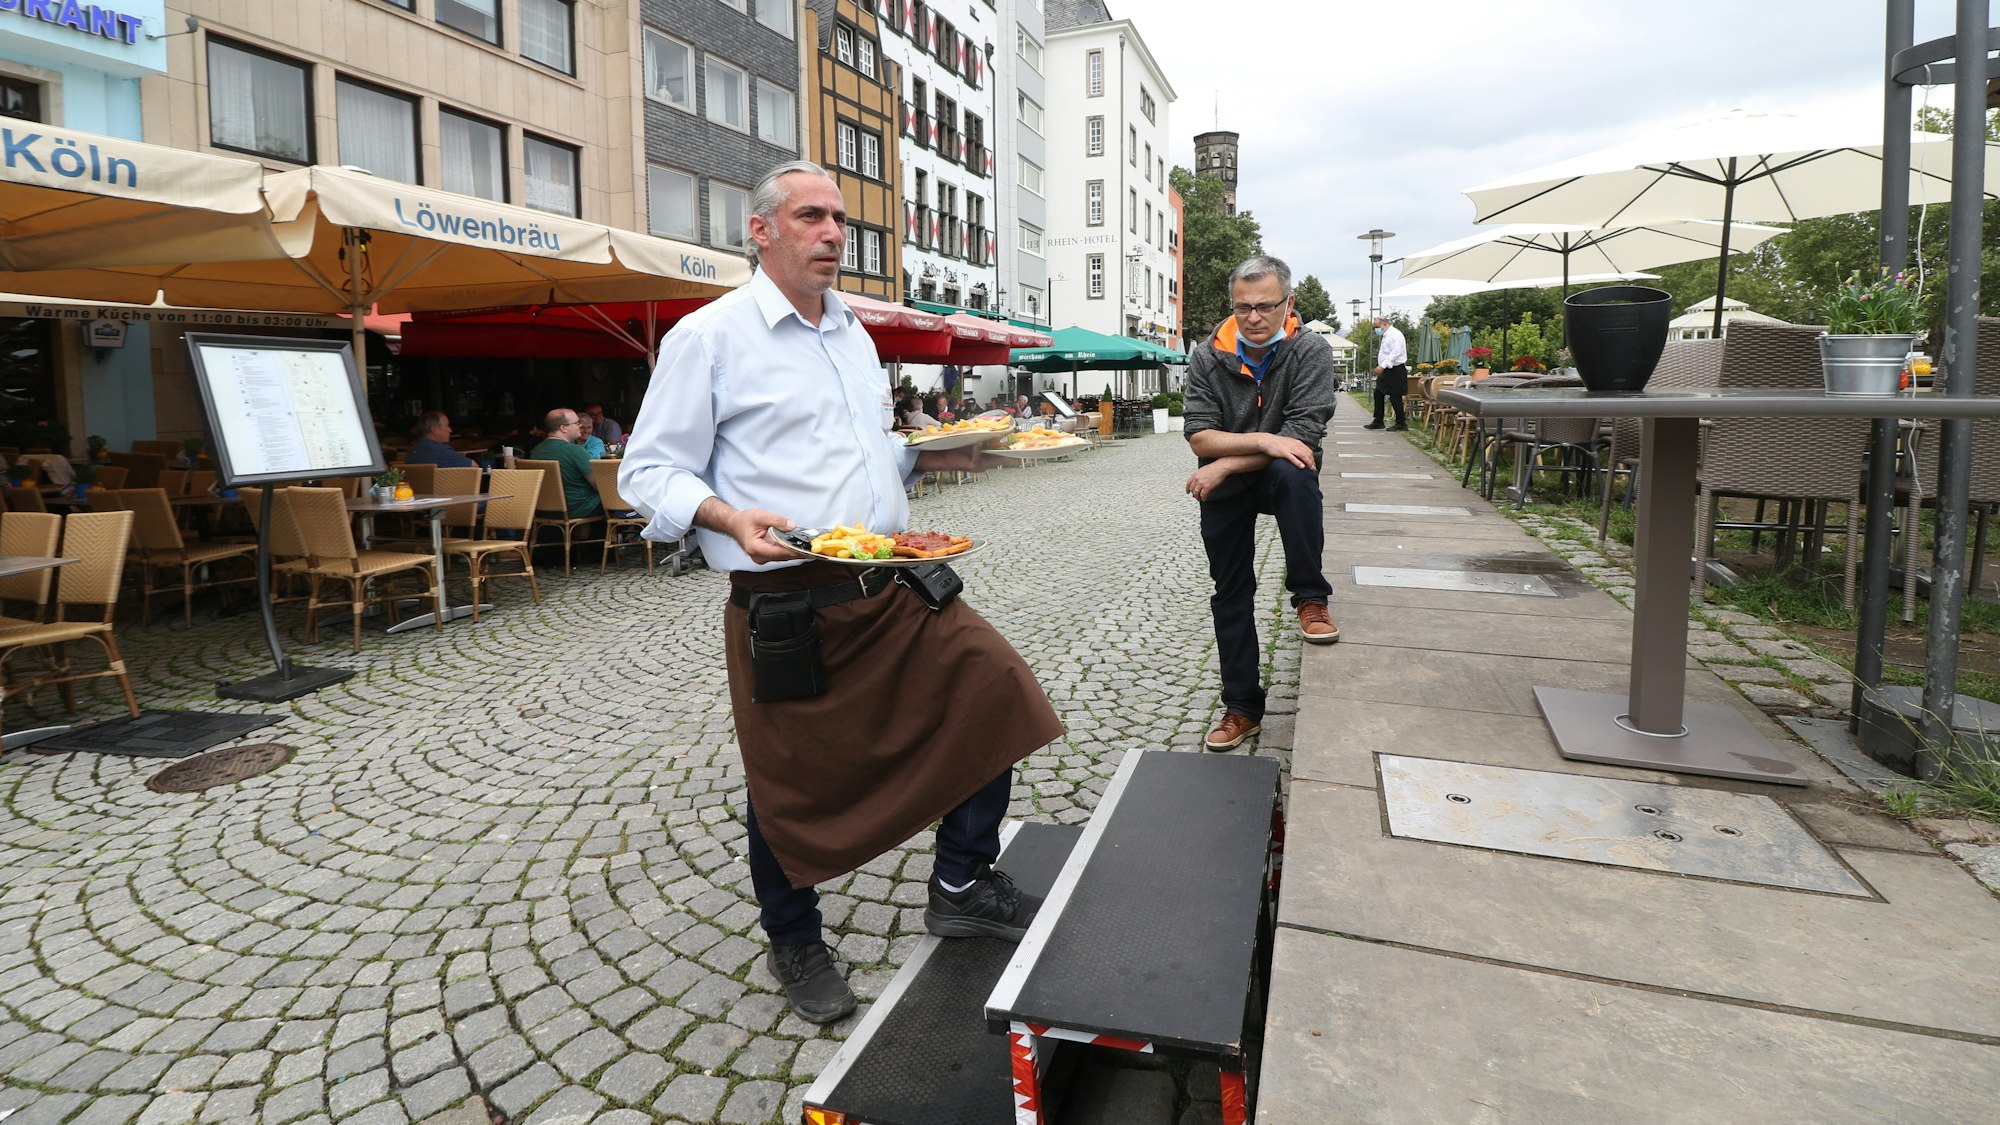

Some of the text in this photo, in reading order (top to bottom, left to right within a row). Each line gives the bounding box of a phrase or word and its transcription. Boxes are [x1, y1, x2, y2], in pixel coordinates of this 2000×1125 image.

[2, 127, 138, 188] Köln
[394, 197, 560, 252] Löwenbräu
[1047, 234, 1117, 247] RHEIN-HOTEL
[679, 253, 717, 280] Köln
[26, 305, 329, 327] Warme Küche von 11:00 bis 03:00 Uhr
